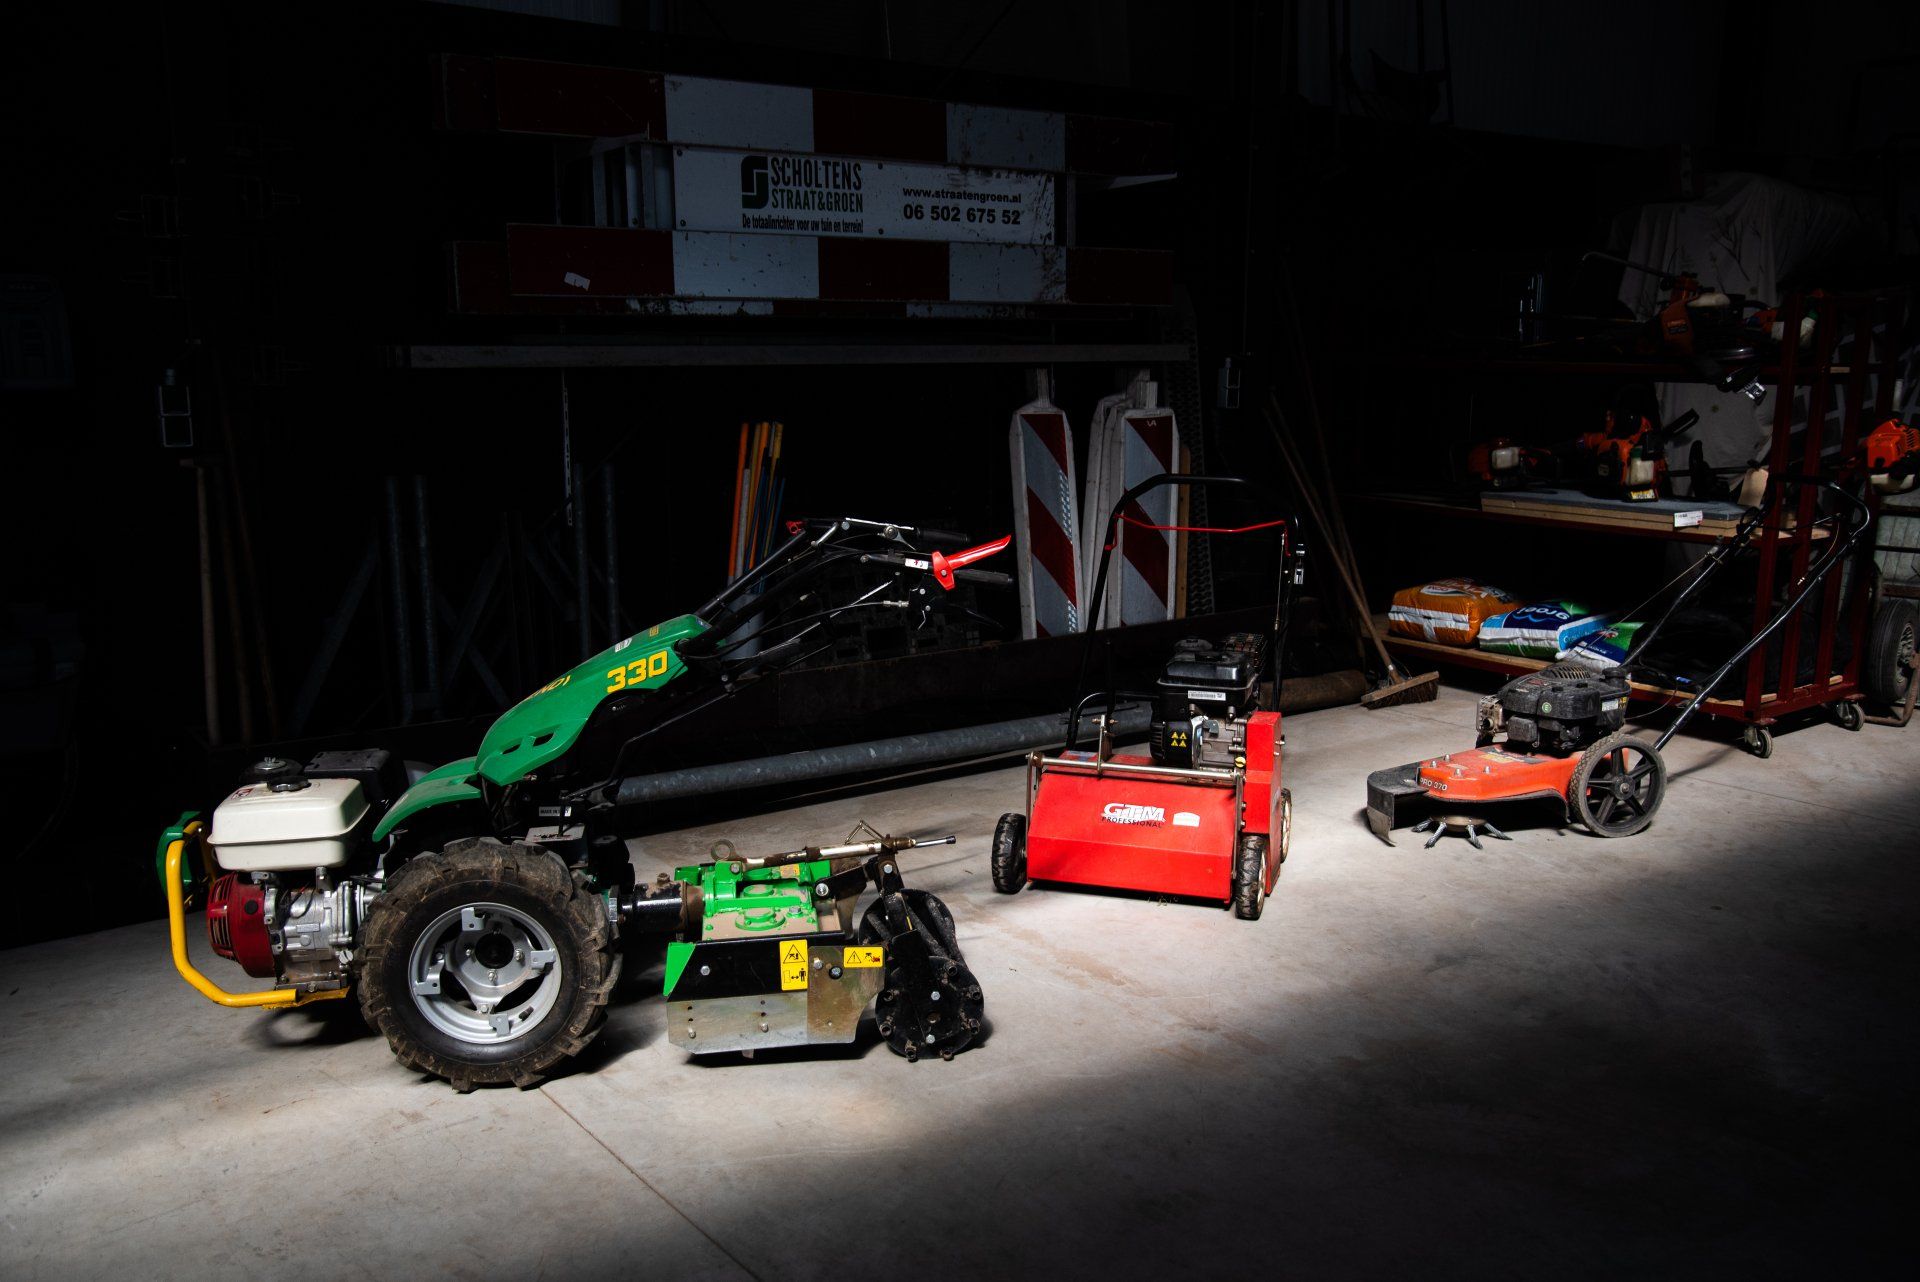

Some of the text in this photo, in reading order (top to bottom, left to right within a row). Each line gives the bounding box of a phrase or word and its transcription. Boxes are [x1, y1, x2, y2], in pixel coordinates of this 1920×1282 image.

[771, 157, 862, 190] SCHOLTENS
[771, 188, 863, 213] STRAAT&GROEN
[903, 188, 1021, 203] www.straatengroen.nl
[742, 213, 863, 233] De totaalinrichter voor uw tuin en terrein!
[903, 204, 1021, 225] 06 502 675 52
[606, 650, 668, 694] 330
[1433, 781, 1448, 791] 370
[1101, 816, 1162, 828] PROFESSIONAL
[1103, 803, 1165, 821] GTM
